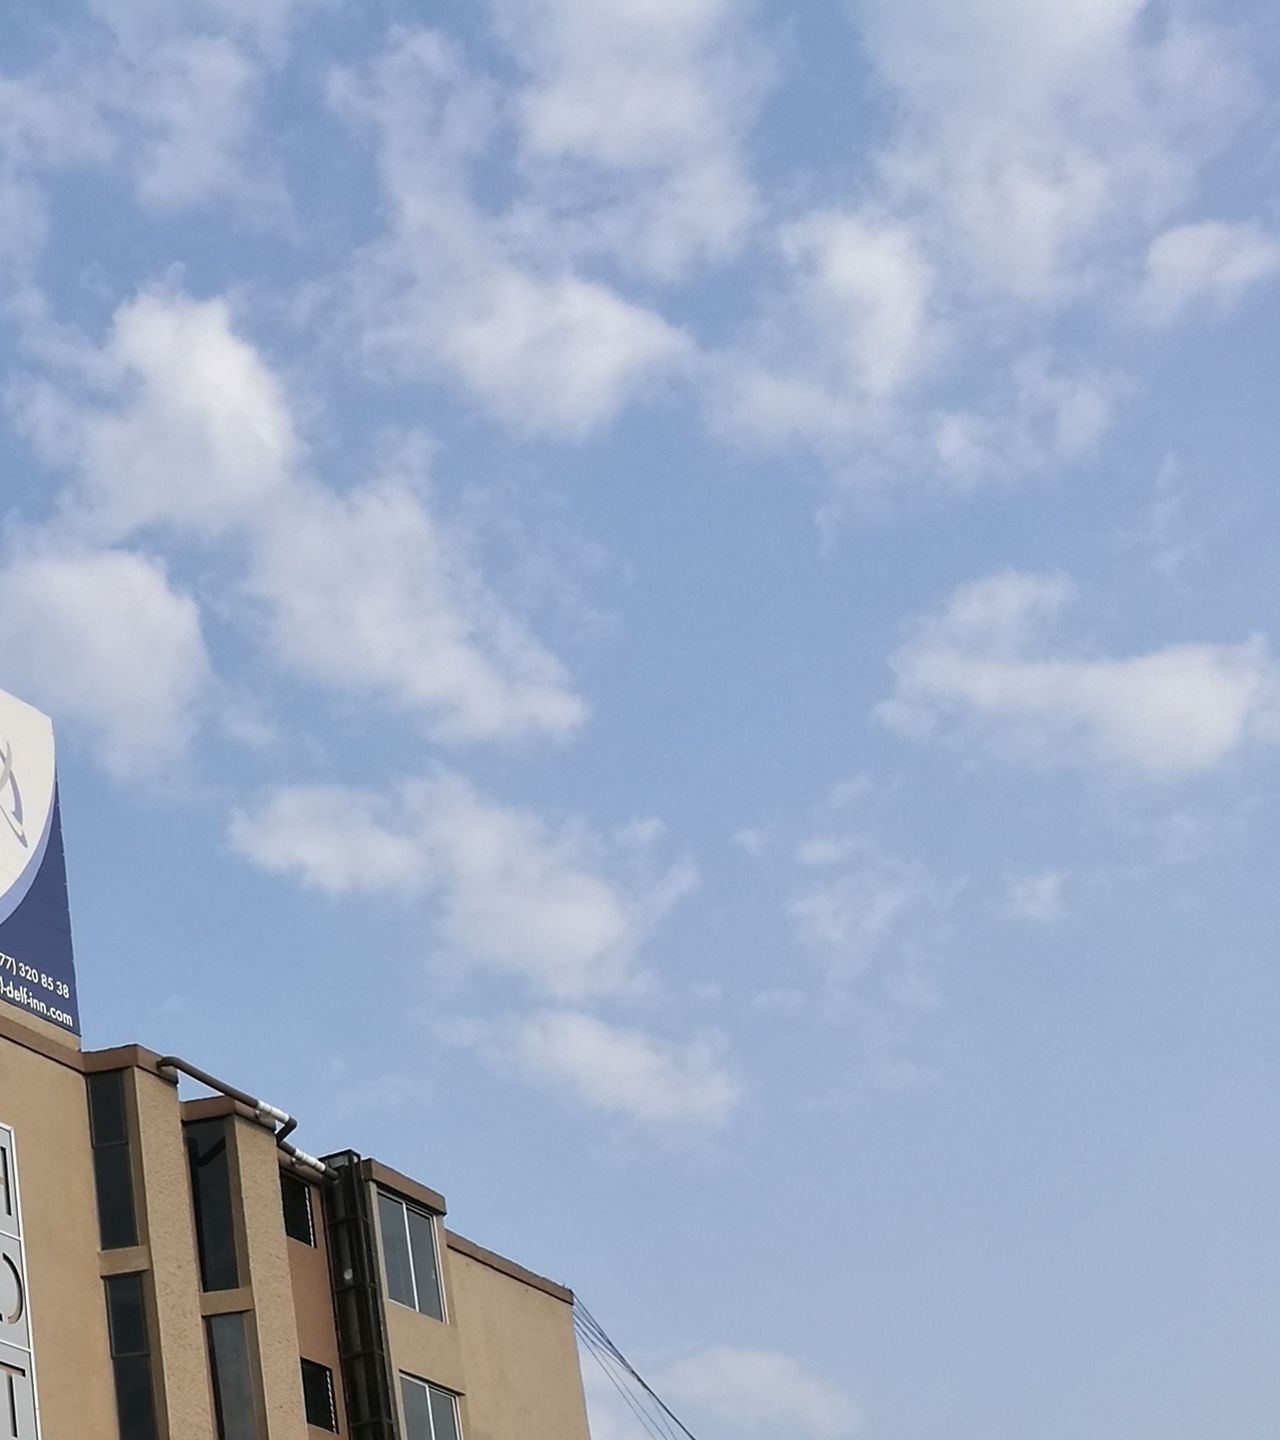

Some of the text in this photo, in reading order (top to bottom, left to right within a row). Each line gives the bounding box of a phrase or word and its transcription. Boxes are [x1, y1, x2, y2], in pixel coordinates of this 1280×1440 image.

[19, 963, 39, 983] 320
[40, 974, 54, 990] 85
[56, 981, 70, 998] 38
